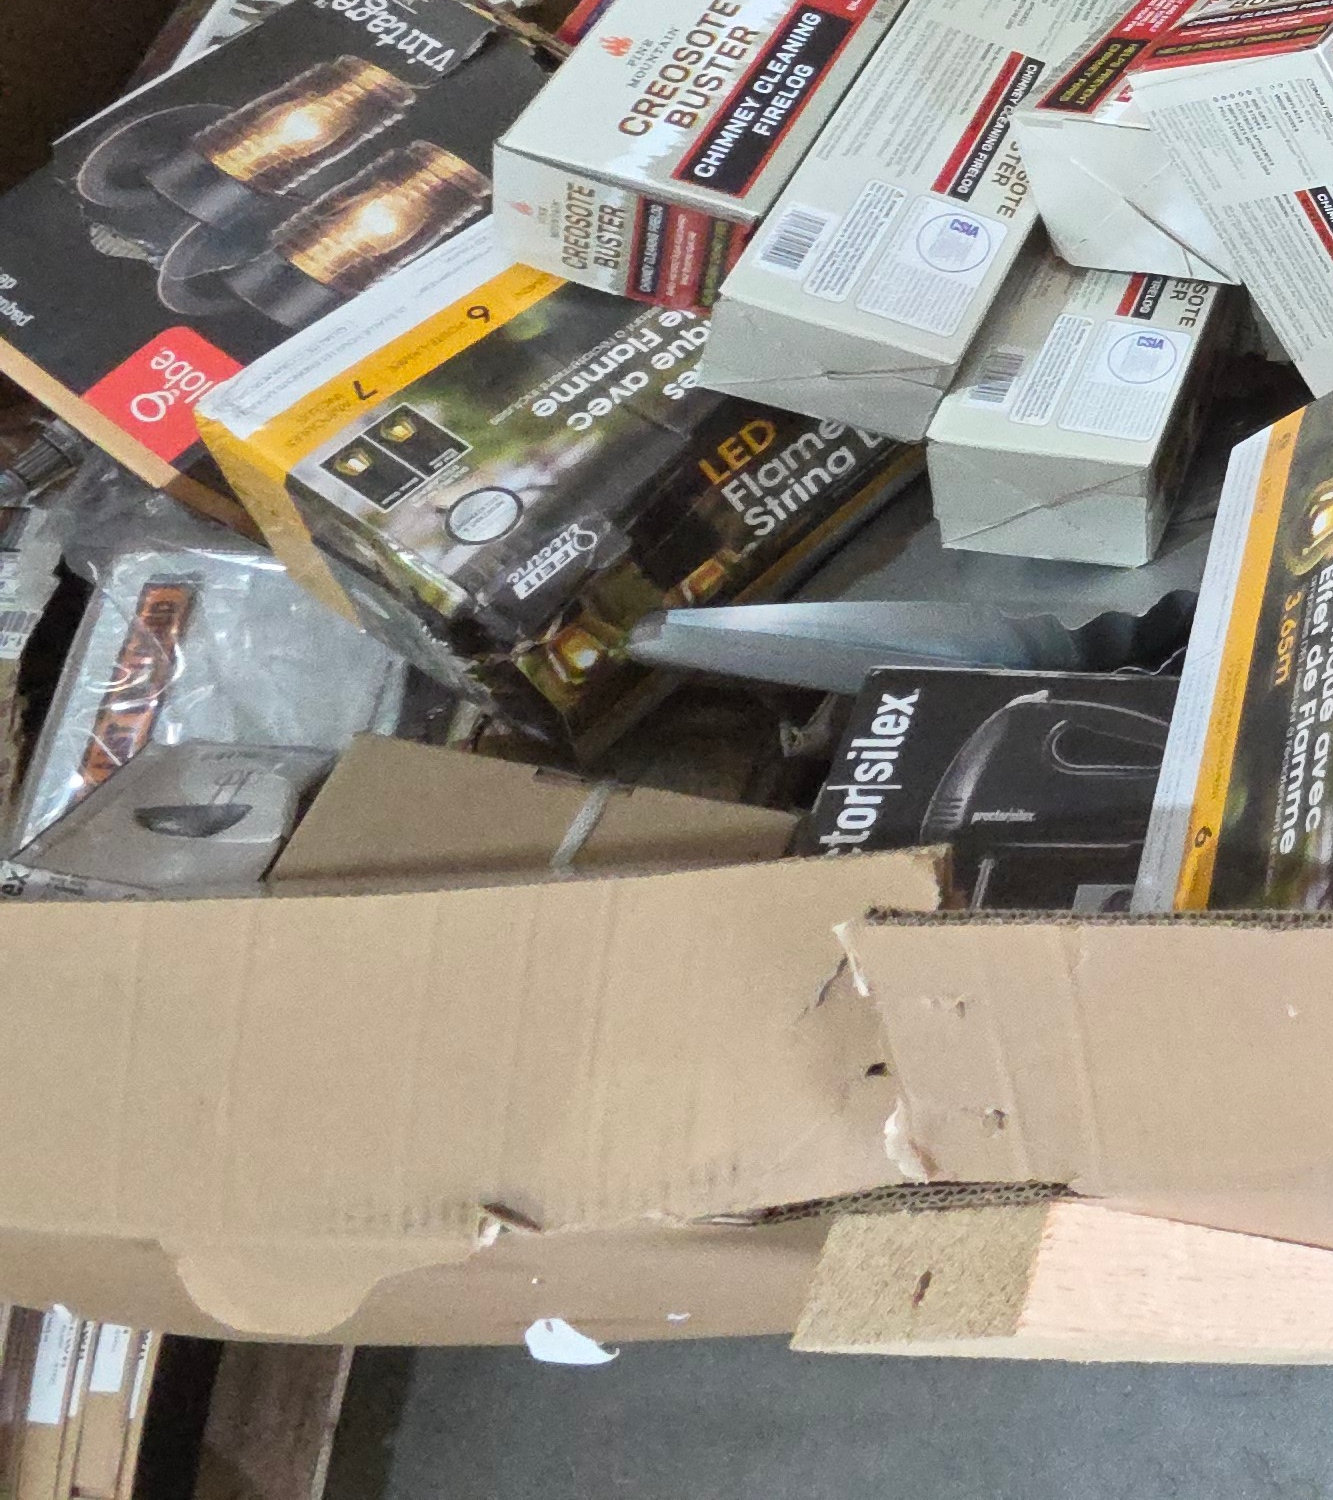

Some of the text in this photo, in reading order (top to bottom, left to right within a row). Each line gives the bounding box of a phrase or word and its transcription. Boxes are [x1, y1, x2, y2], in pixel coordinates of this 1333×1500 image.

[626, 26, 680, 89] MOUNTAIN
[665, 25, 760, 130] BUSTER
[693, 95, 762, 180] CHIMNEY
[753, 9, 822, 96] CLEANING
[751, 62, 815, 138] FIRELOG
[594, 204, 624, 269] BUSTER
[531, 326, 664, 418] Flamme
[567, 372, 649, 432] avec
[698, 420, 777, 486] LED
[721, 418, 846, 513] Flame
[1274, 591, 1302, 686] 3.65m
[1301, 638, 1324, 694] de
[1279, 702, 1314, 856] Flamme
[1304, 732, 1333, 835] avec
